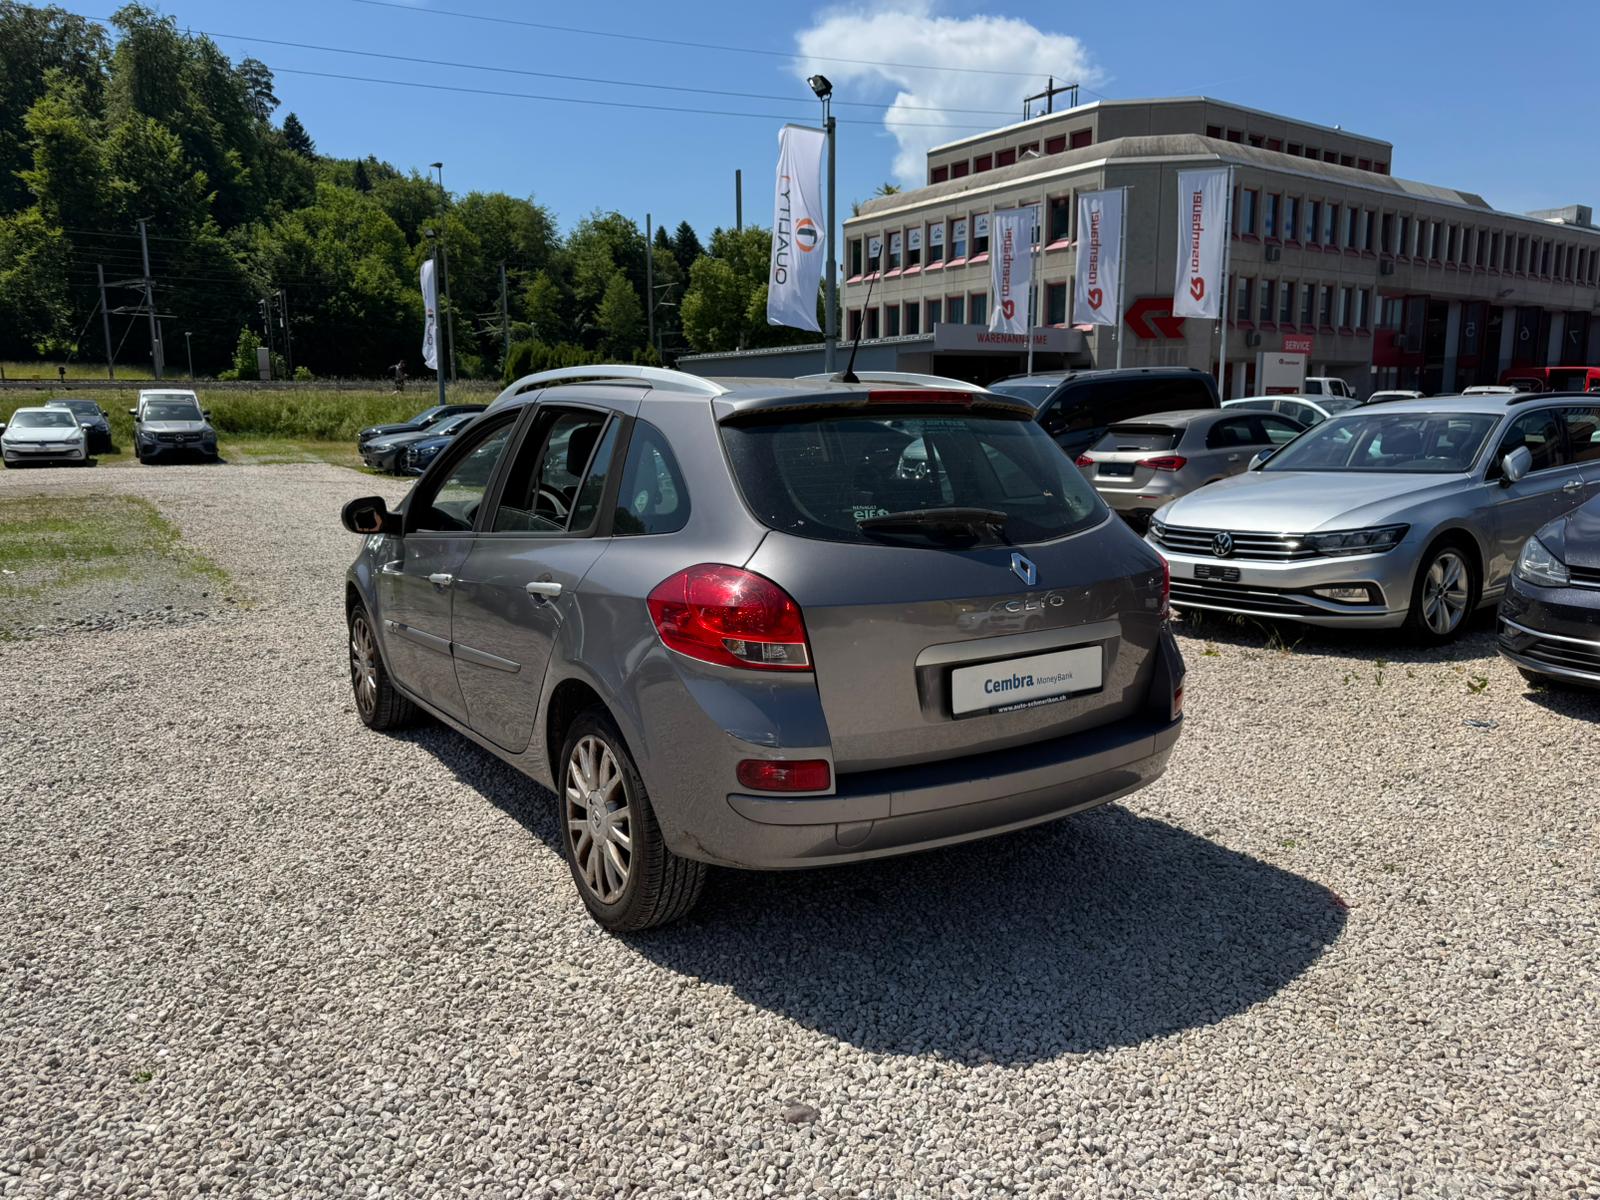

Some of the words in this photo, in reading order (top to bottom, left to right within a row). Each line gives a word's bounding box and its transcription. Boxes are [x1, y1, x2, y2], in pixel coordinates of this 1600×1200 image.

[1284, 340, 1311, 351] SERVICE
[1005, 595, 1065, 613] CLIO
[984, 673, 1034, 694] Cembra
[1036, 672, 1073, 686] MoneyBank
